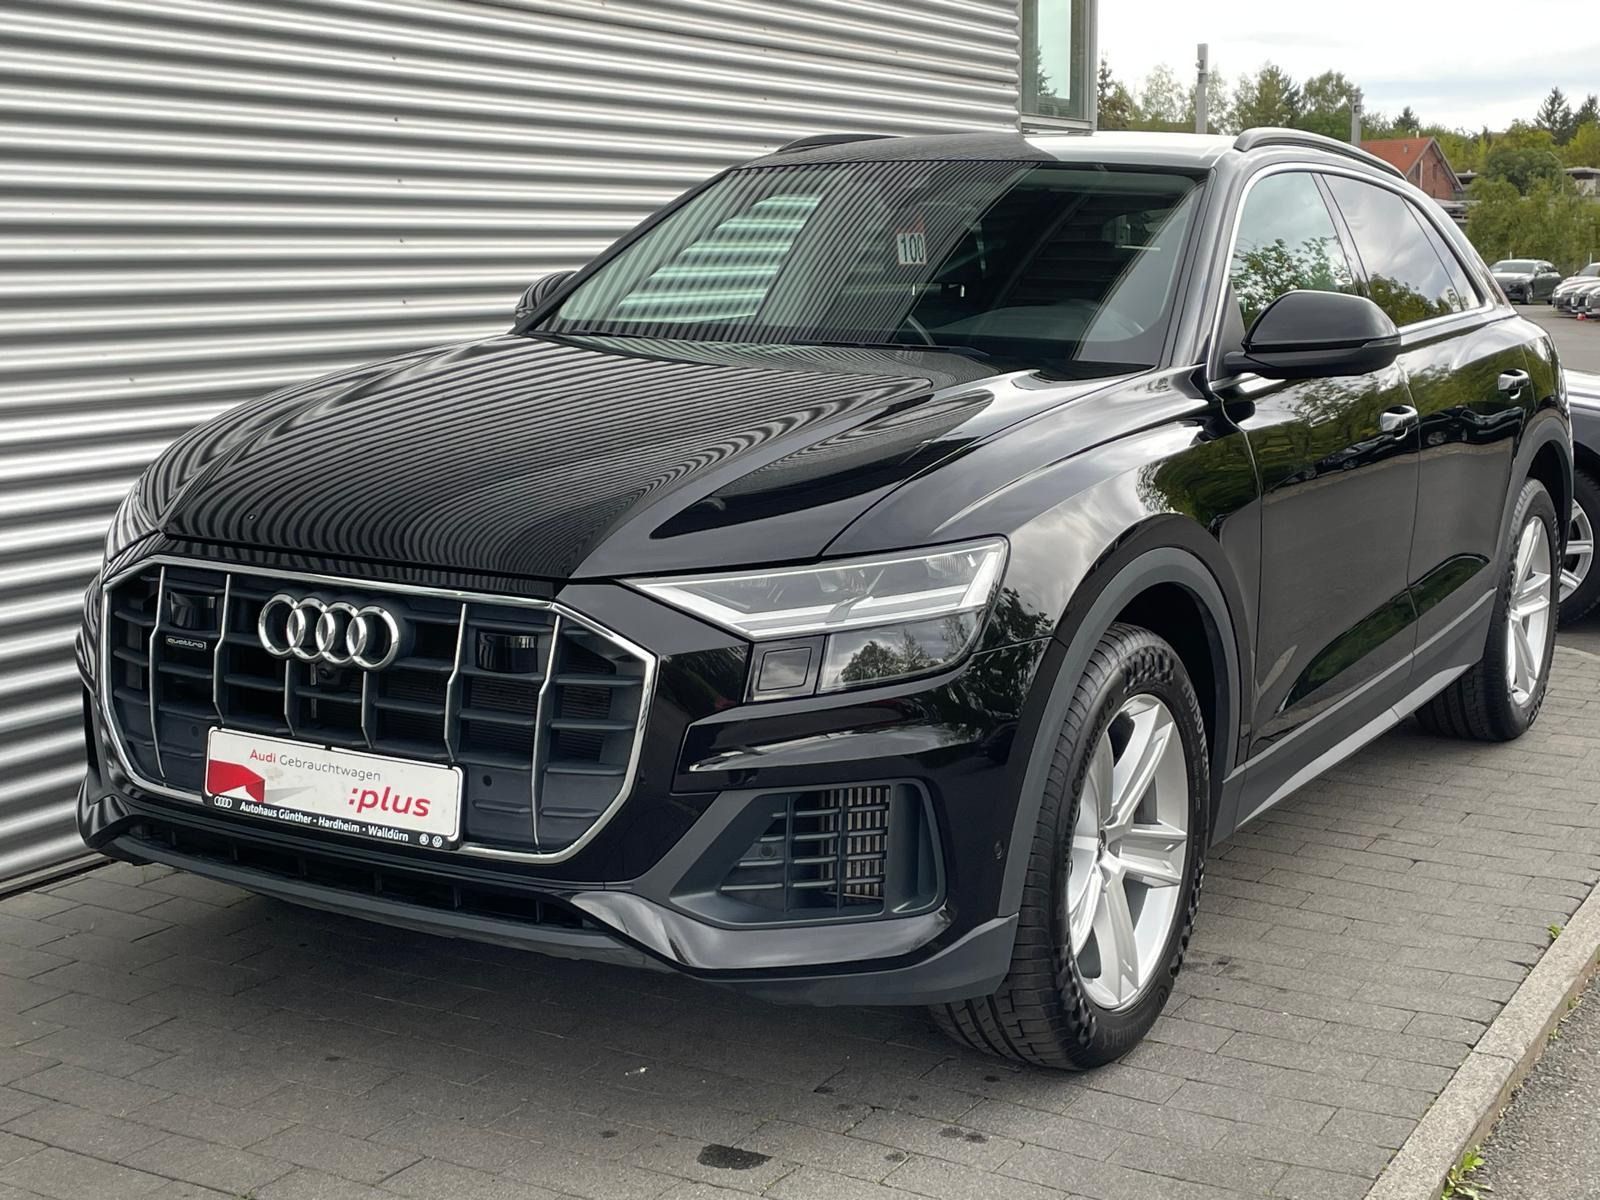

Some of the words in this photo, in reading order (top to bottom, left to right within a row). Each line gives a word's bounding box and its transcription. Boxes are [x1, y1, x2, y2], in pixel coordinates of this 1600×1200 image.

[901, 233, 924, 263] 100
[167, 638, 204, 649] quattro
[250, 749, 276, 763] Audi
[279, 755, 381, 781] Gebrauchtwagen
[240, 801, 277, 818] Autohaus
[278, 809, 312, 825] Günther
[318, 817, 360, 833] Hardheim
[368, 825, 409, 842] Walldürn
